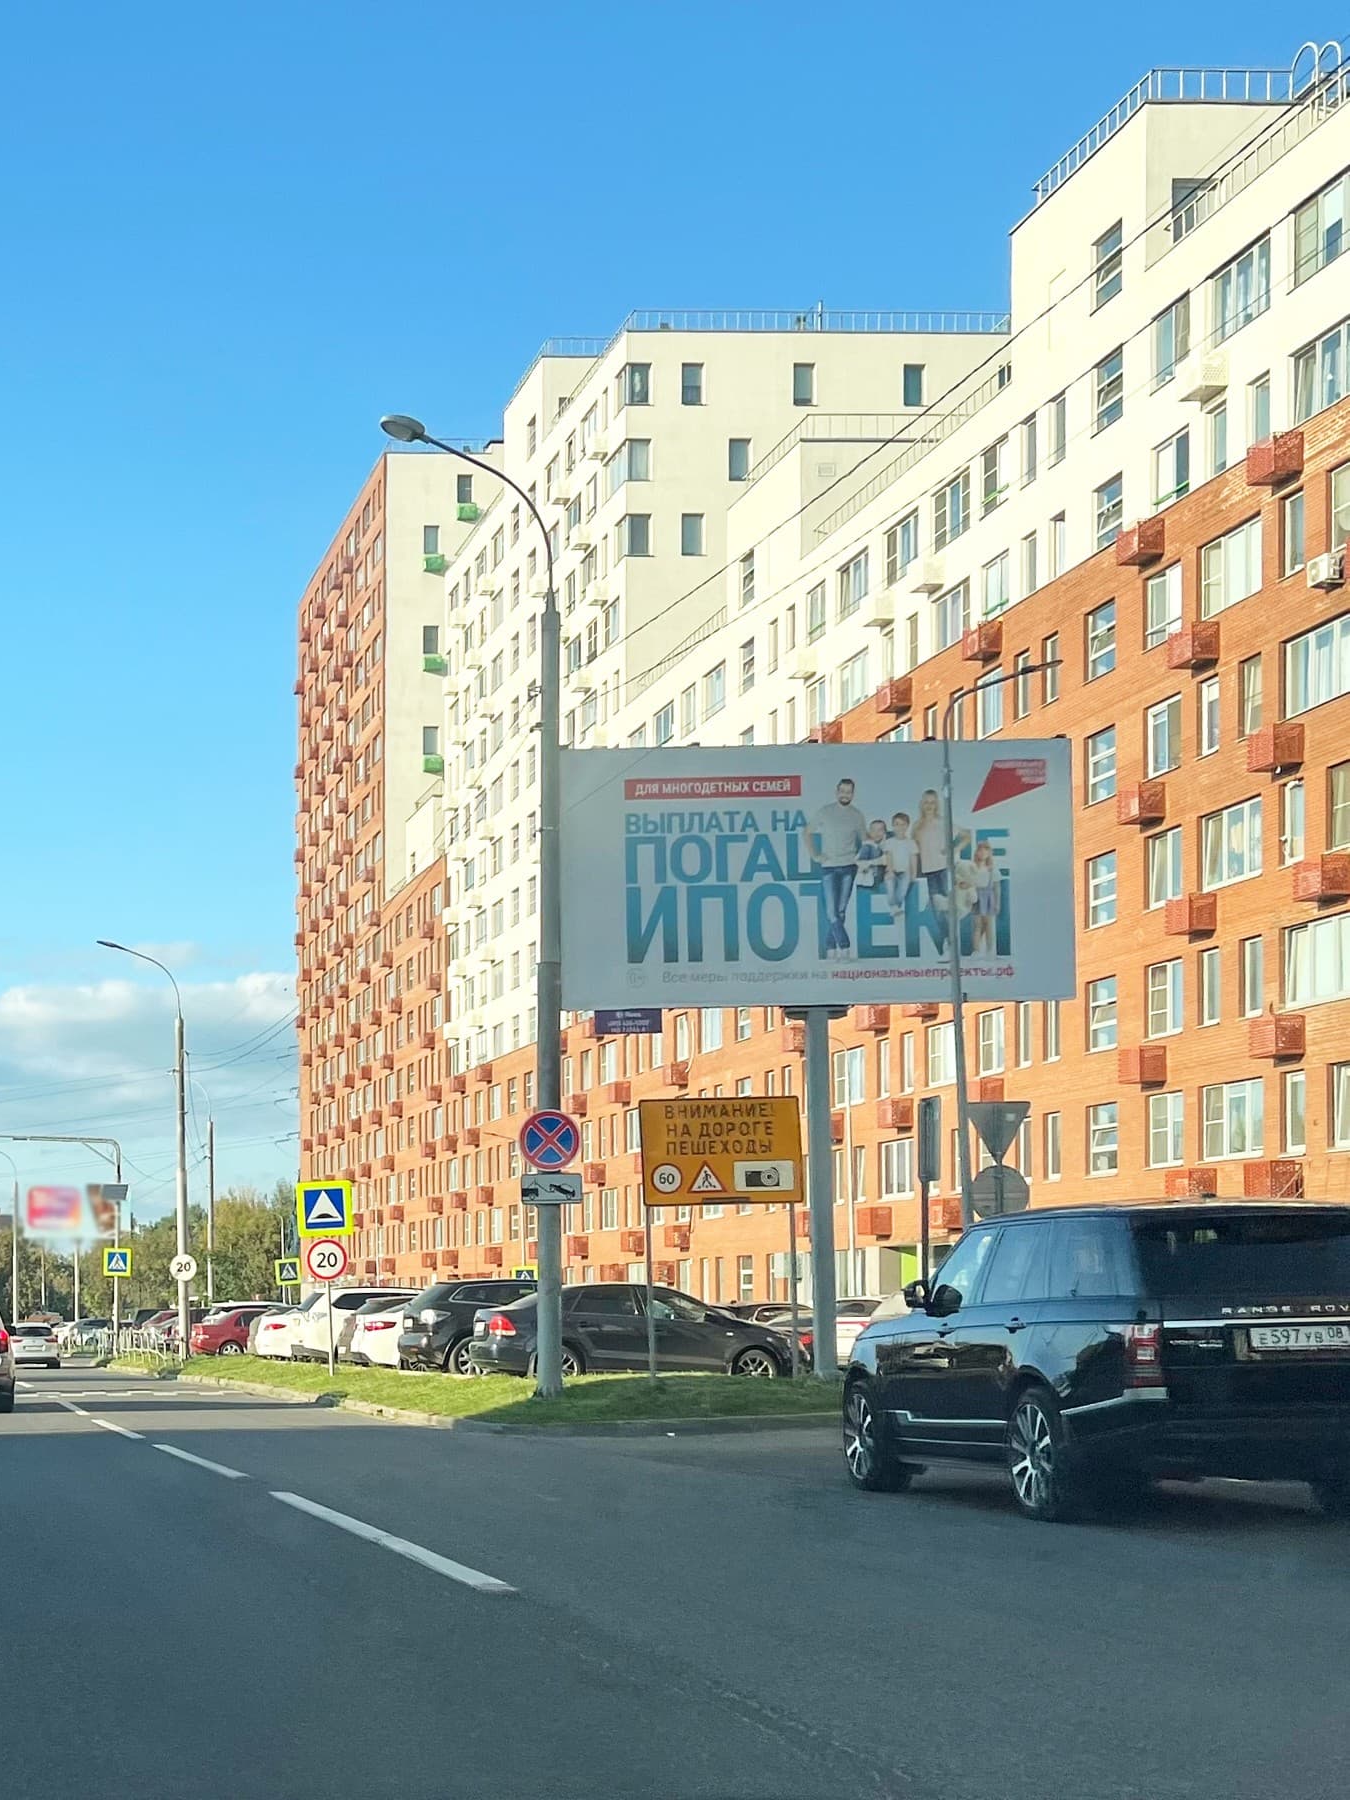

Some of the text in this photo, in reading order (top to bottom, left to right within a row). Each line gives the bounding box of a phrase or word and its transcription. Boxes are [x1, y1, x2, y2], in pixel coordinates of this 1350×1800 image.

[635, 778, 791, 796] ДЛЯ МНОГОДЕТНЫХ СЕМЕЙ
[625, 810, 807, 834] ВЫПЛАТА НА
[662, 964, 1014, 985] Все меры поддержки на национальныепректы.рф
[664, 1103, 774, 1120] ВНИМАНИЕ!
[666, 1121, 774, 1139] НА ДОРОГЕ
[666, 1139, 772, 1156] ПЕШЕХОДЫ
[658, 1173, 675, 1185] 60
[176, 1261, 191, 1272] 20
[316, 1252, 338, 1268] 20
[1221, 1305, 1291, 1314] RANGE
